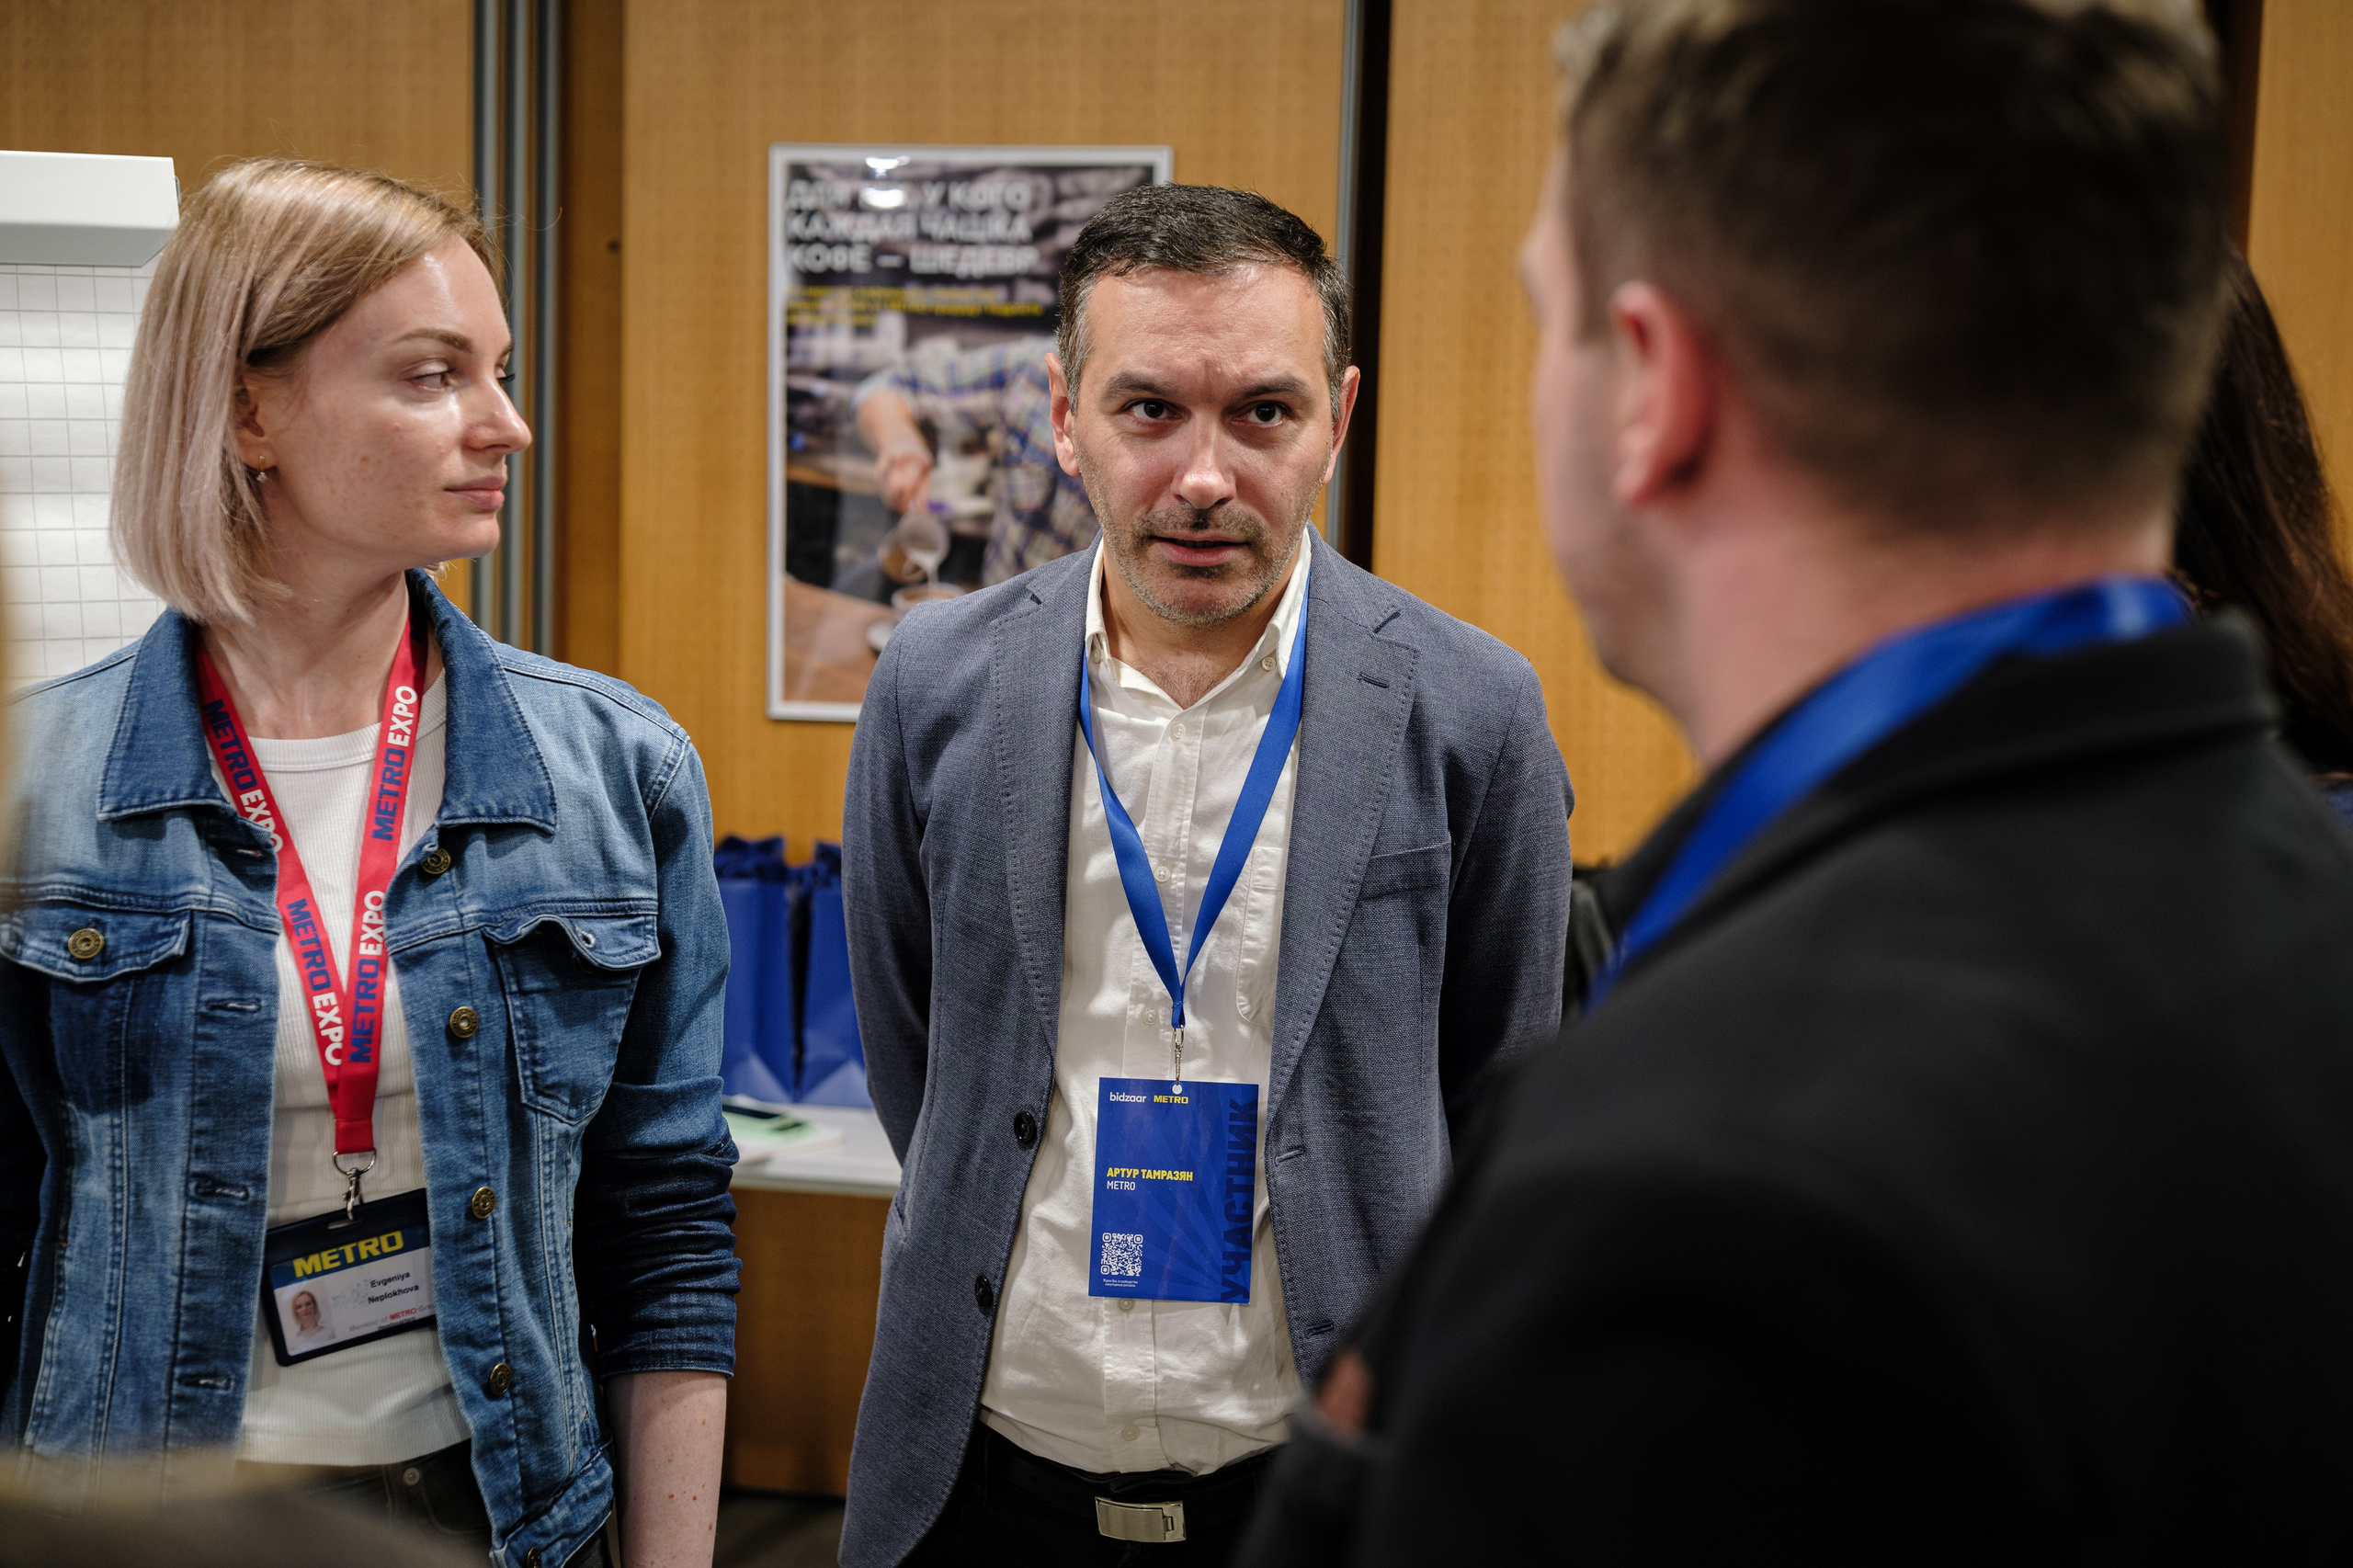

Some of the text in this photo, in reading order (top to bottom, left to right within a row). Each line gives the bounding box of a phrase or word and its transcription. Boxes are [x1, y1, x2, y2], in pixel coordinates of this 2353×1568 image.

[948, 181, 1033, 212] КОГО
[788, 211, 1033, 244] КАЖДАЯ ЧАШКА
[789, 243, 872, 274] КОФЕ
[203, 699, 257, 791] METRO
[372, 686, 417, 840] METRO EXPO
[287, 898, 344, 1065] METRO EXPO
[349, 891, 385, 1062] METRO EXPO
[1109, 1092, 1188, 1104] bidzaar METRO
[1107, 1167, 1193, 1182] АРТУР ТАМРАЗЯН
[1107, 1180, 1136, 1191] METRO
[1220, 1097, 1257, 1302] УЧАСТНИК
[292, 1230, 404, 1278] METRO
[368, 1284, 419, 1304] Neplokhova
[370, 1272, 410, 1288] Evgeniya
[389, 1307, 417, 1321] METRO
